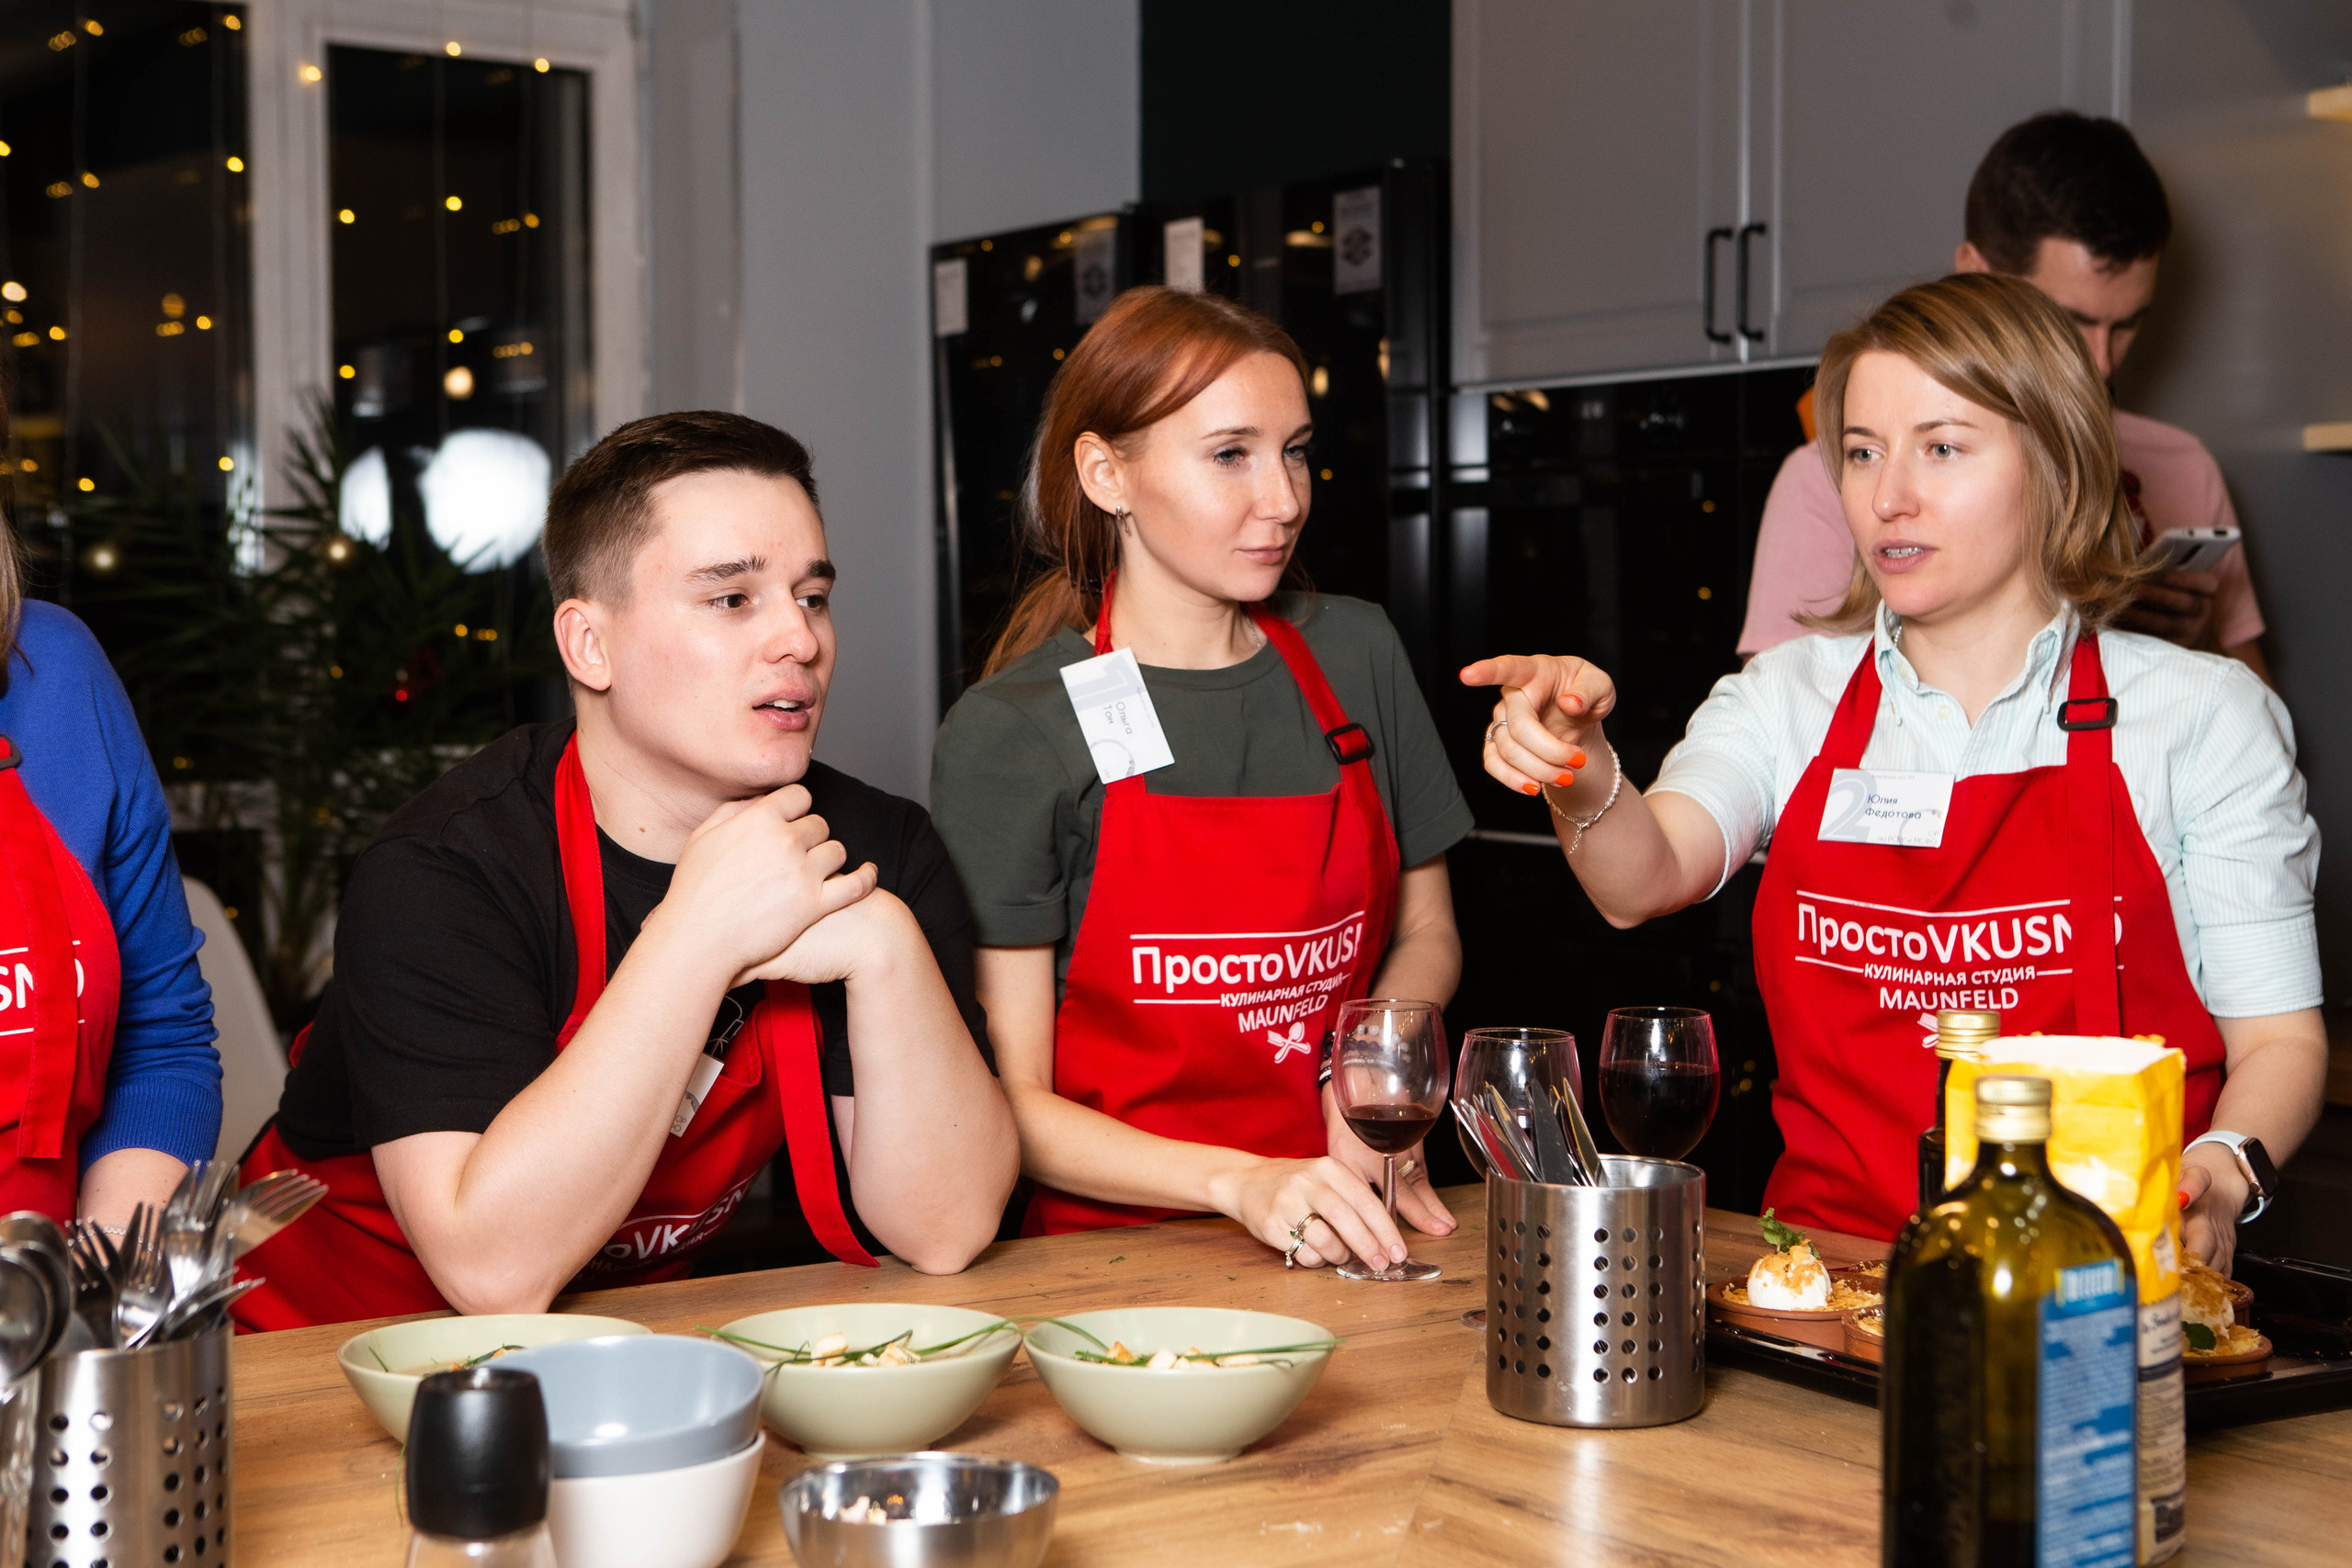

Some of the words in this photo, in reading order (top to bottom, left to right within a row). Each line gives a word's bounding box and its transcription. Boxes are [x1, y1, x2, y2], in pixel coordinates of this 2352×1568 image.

[1103, 705, 1114, 724] Тон
[1115, 702, 1133, 735] Ольга
[1867, 794, 1898, 804] Юлия
[1865, 807, 1922, 819] Федотова
[1798, 903, 2122, 964] ПростоVKUSN
[1864, 963, 1966, 987] КУЛИНАРНАЯ
[1971, 965, 2036, 986] СТУДИЯ
[1221, 984, 1306, 1008] КУЛИНАРНАЯ
[1305, 972, 1343, 994] СТУДИЯ
[1879, 987, 2018, 1010] MAUNFELD
[1238, 994, 1329, 1033] MAUNFELD
